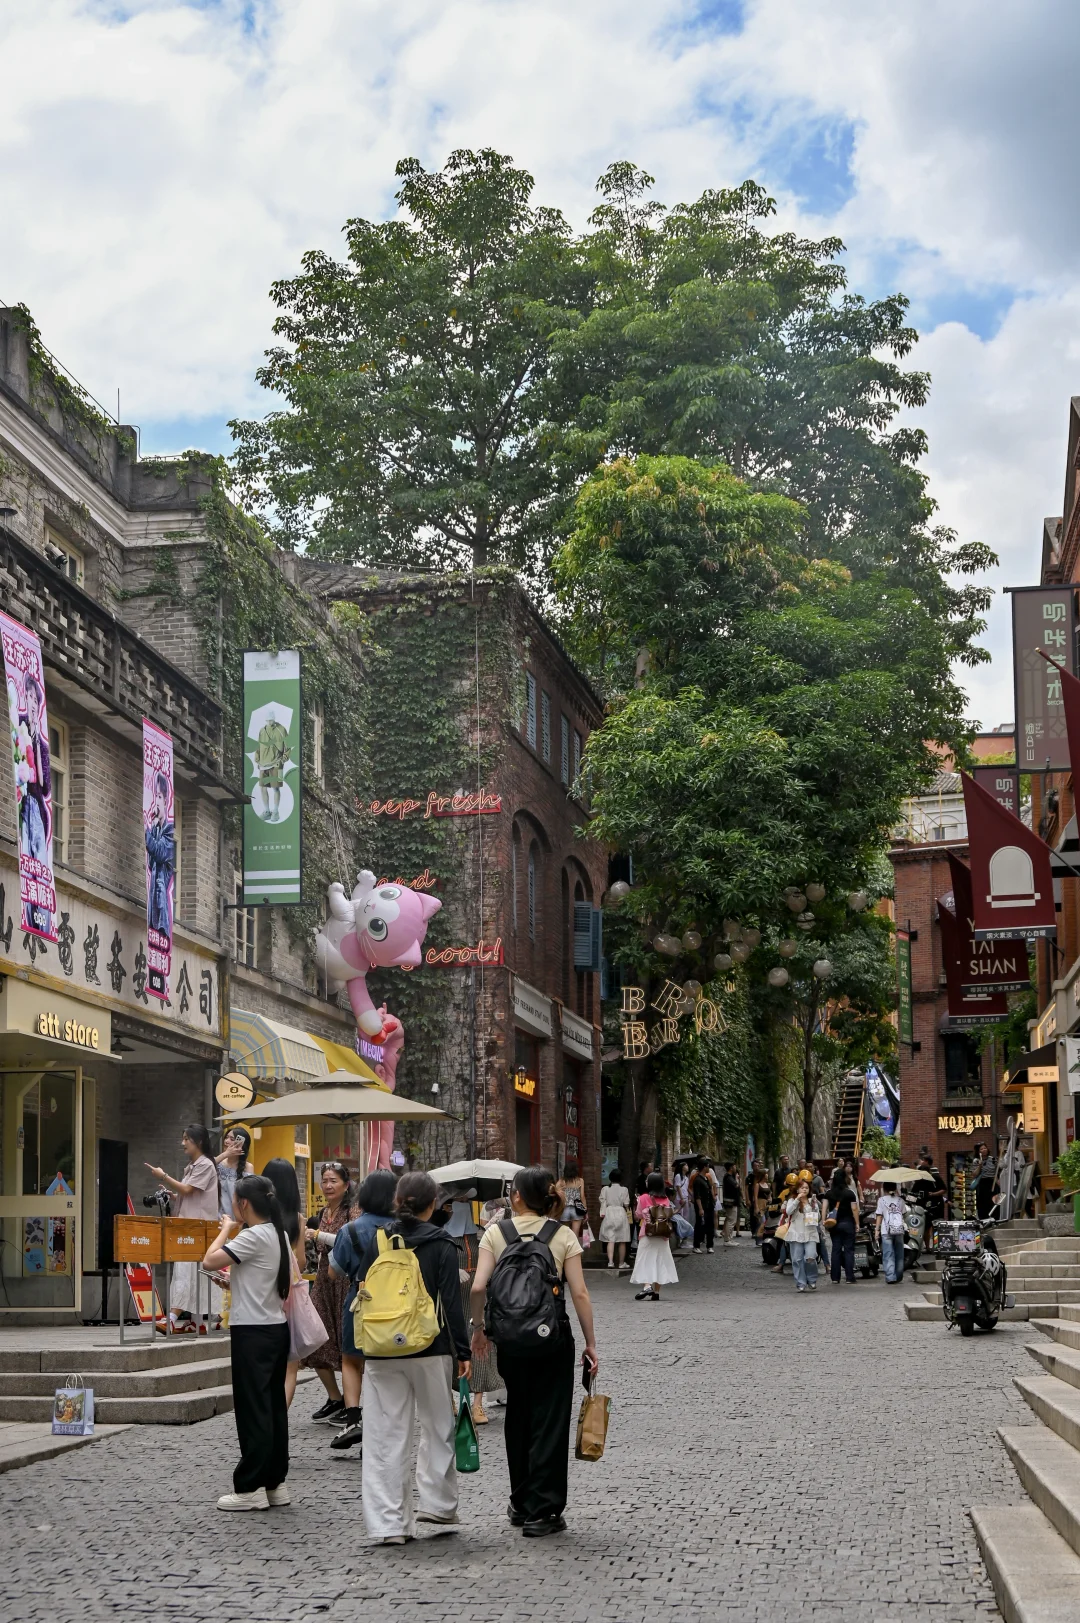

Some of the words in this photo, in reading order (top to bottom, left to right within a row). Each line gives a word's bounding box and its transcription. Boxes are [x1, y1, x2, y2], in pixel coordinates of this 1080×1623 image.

[368, 799, 420, 820] eep
[424, 788, 501, 818] fresh
[425, 937, 501, 964] cool!
[970, 958, 1016, 976] SHAN
[38, 1012, 60, 1039] att
[64, 1018, 99, 1049] store
[938, 1114, 991, 1129] MODERN
